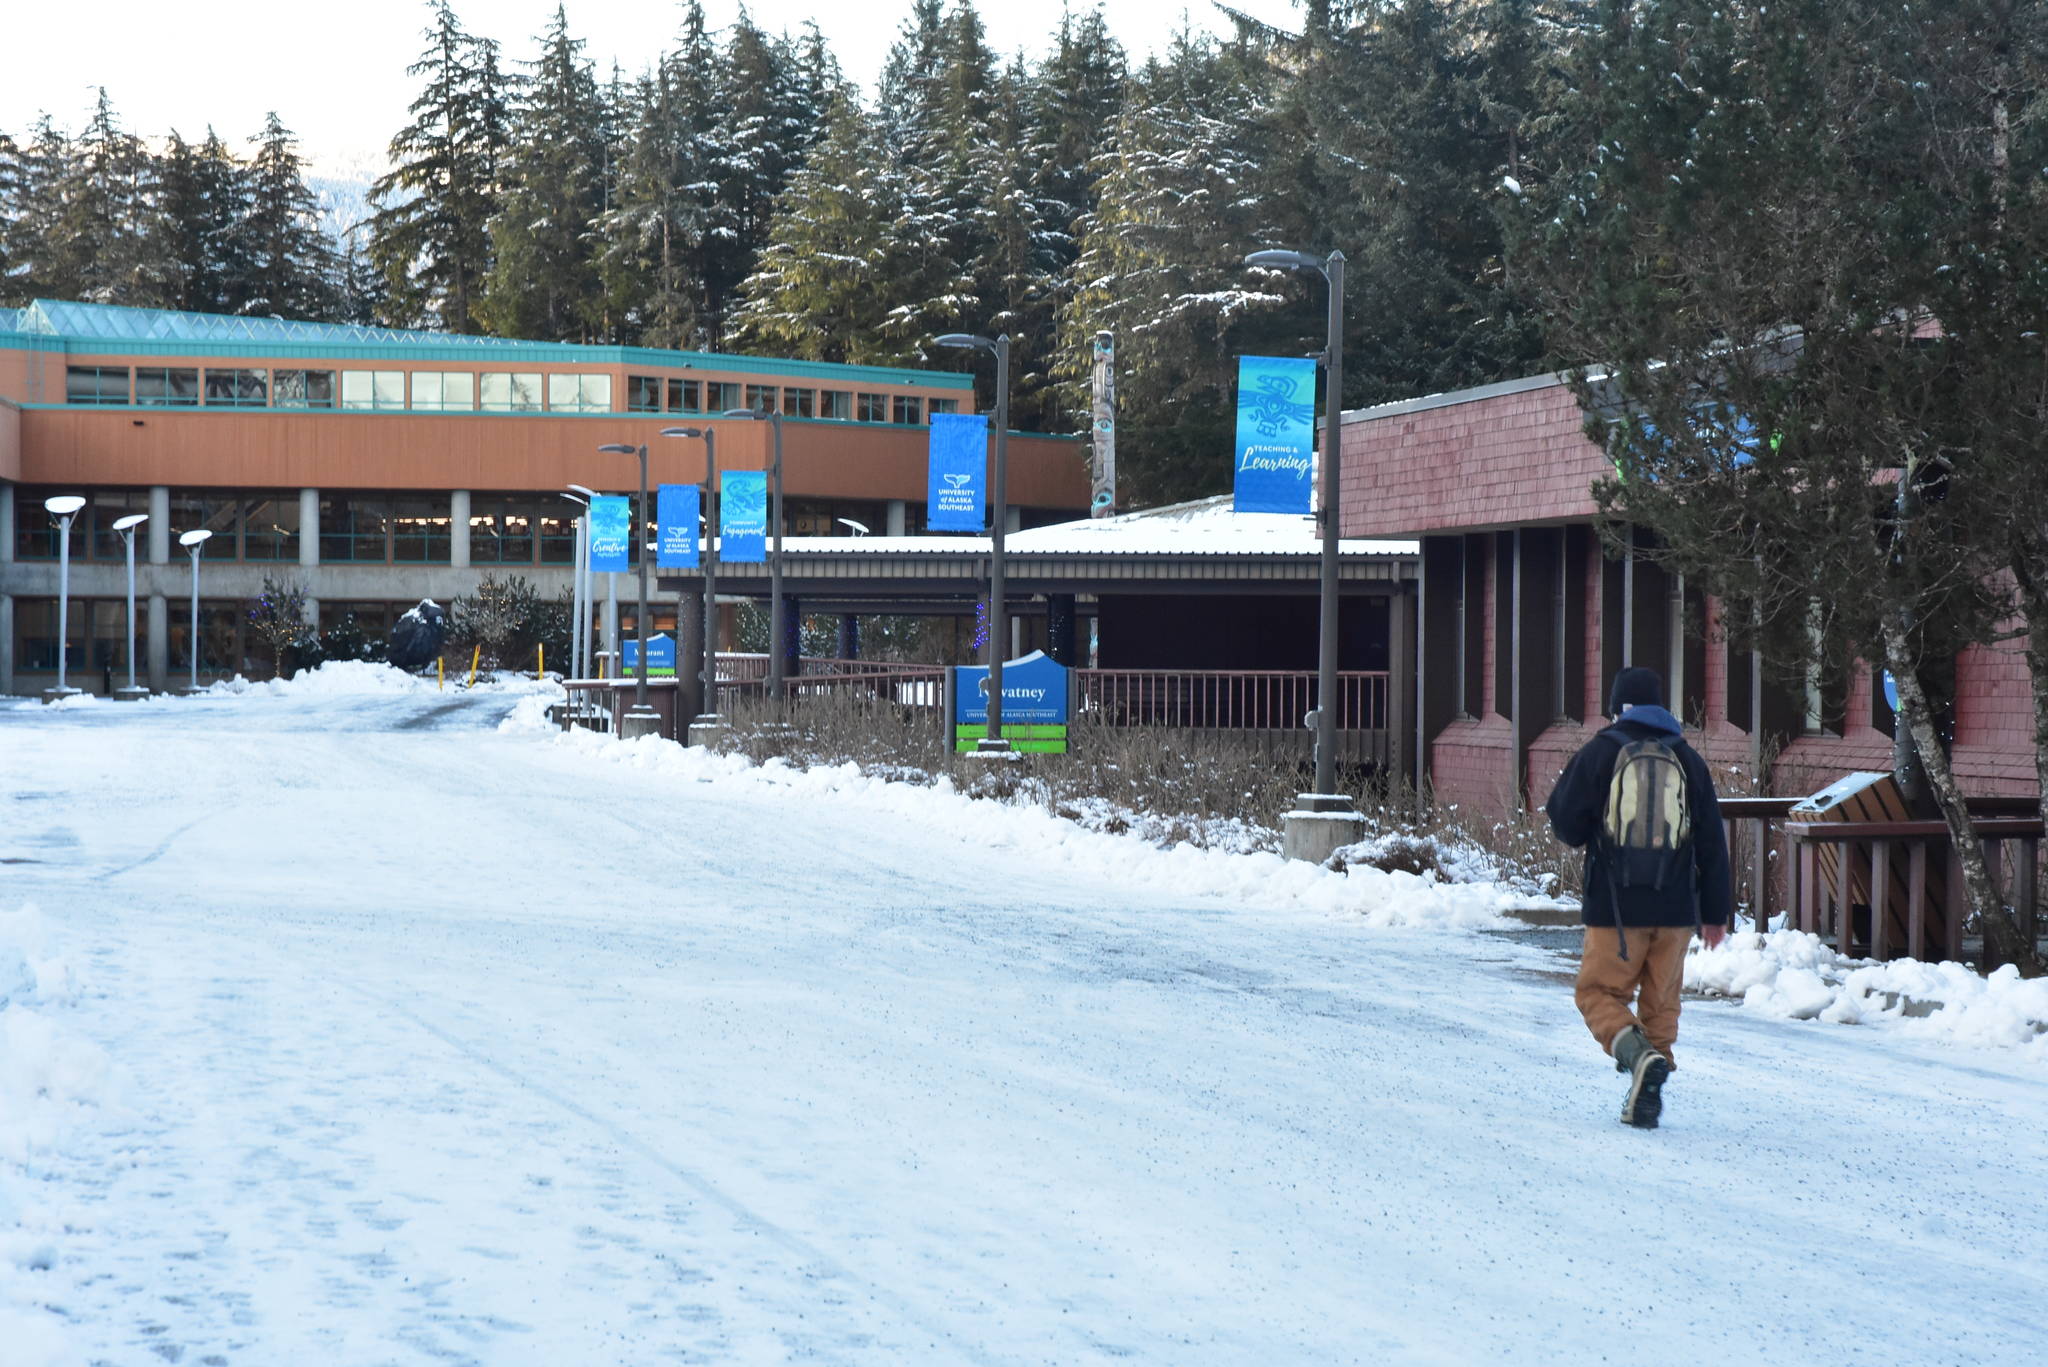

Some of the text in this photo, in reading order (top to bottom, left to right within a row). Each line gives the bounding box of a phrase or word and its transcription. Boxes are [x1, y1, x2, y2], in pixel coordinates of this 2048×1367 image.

[1253, 445, 1298, 454] TEACHING &
[1239, 446, 1312, 481] Learning
[940, 496, 948, 504] of
[722, 524, 766, 539] Engagement
[592, 540, 627, 553] Creative
